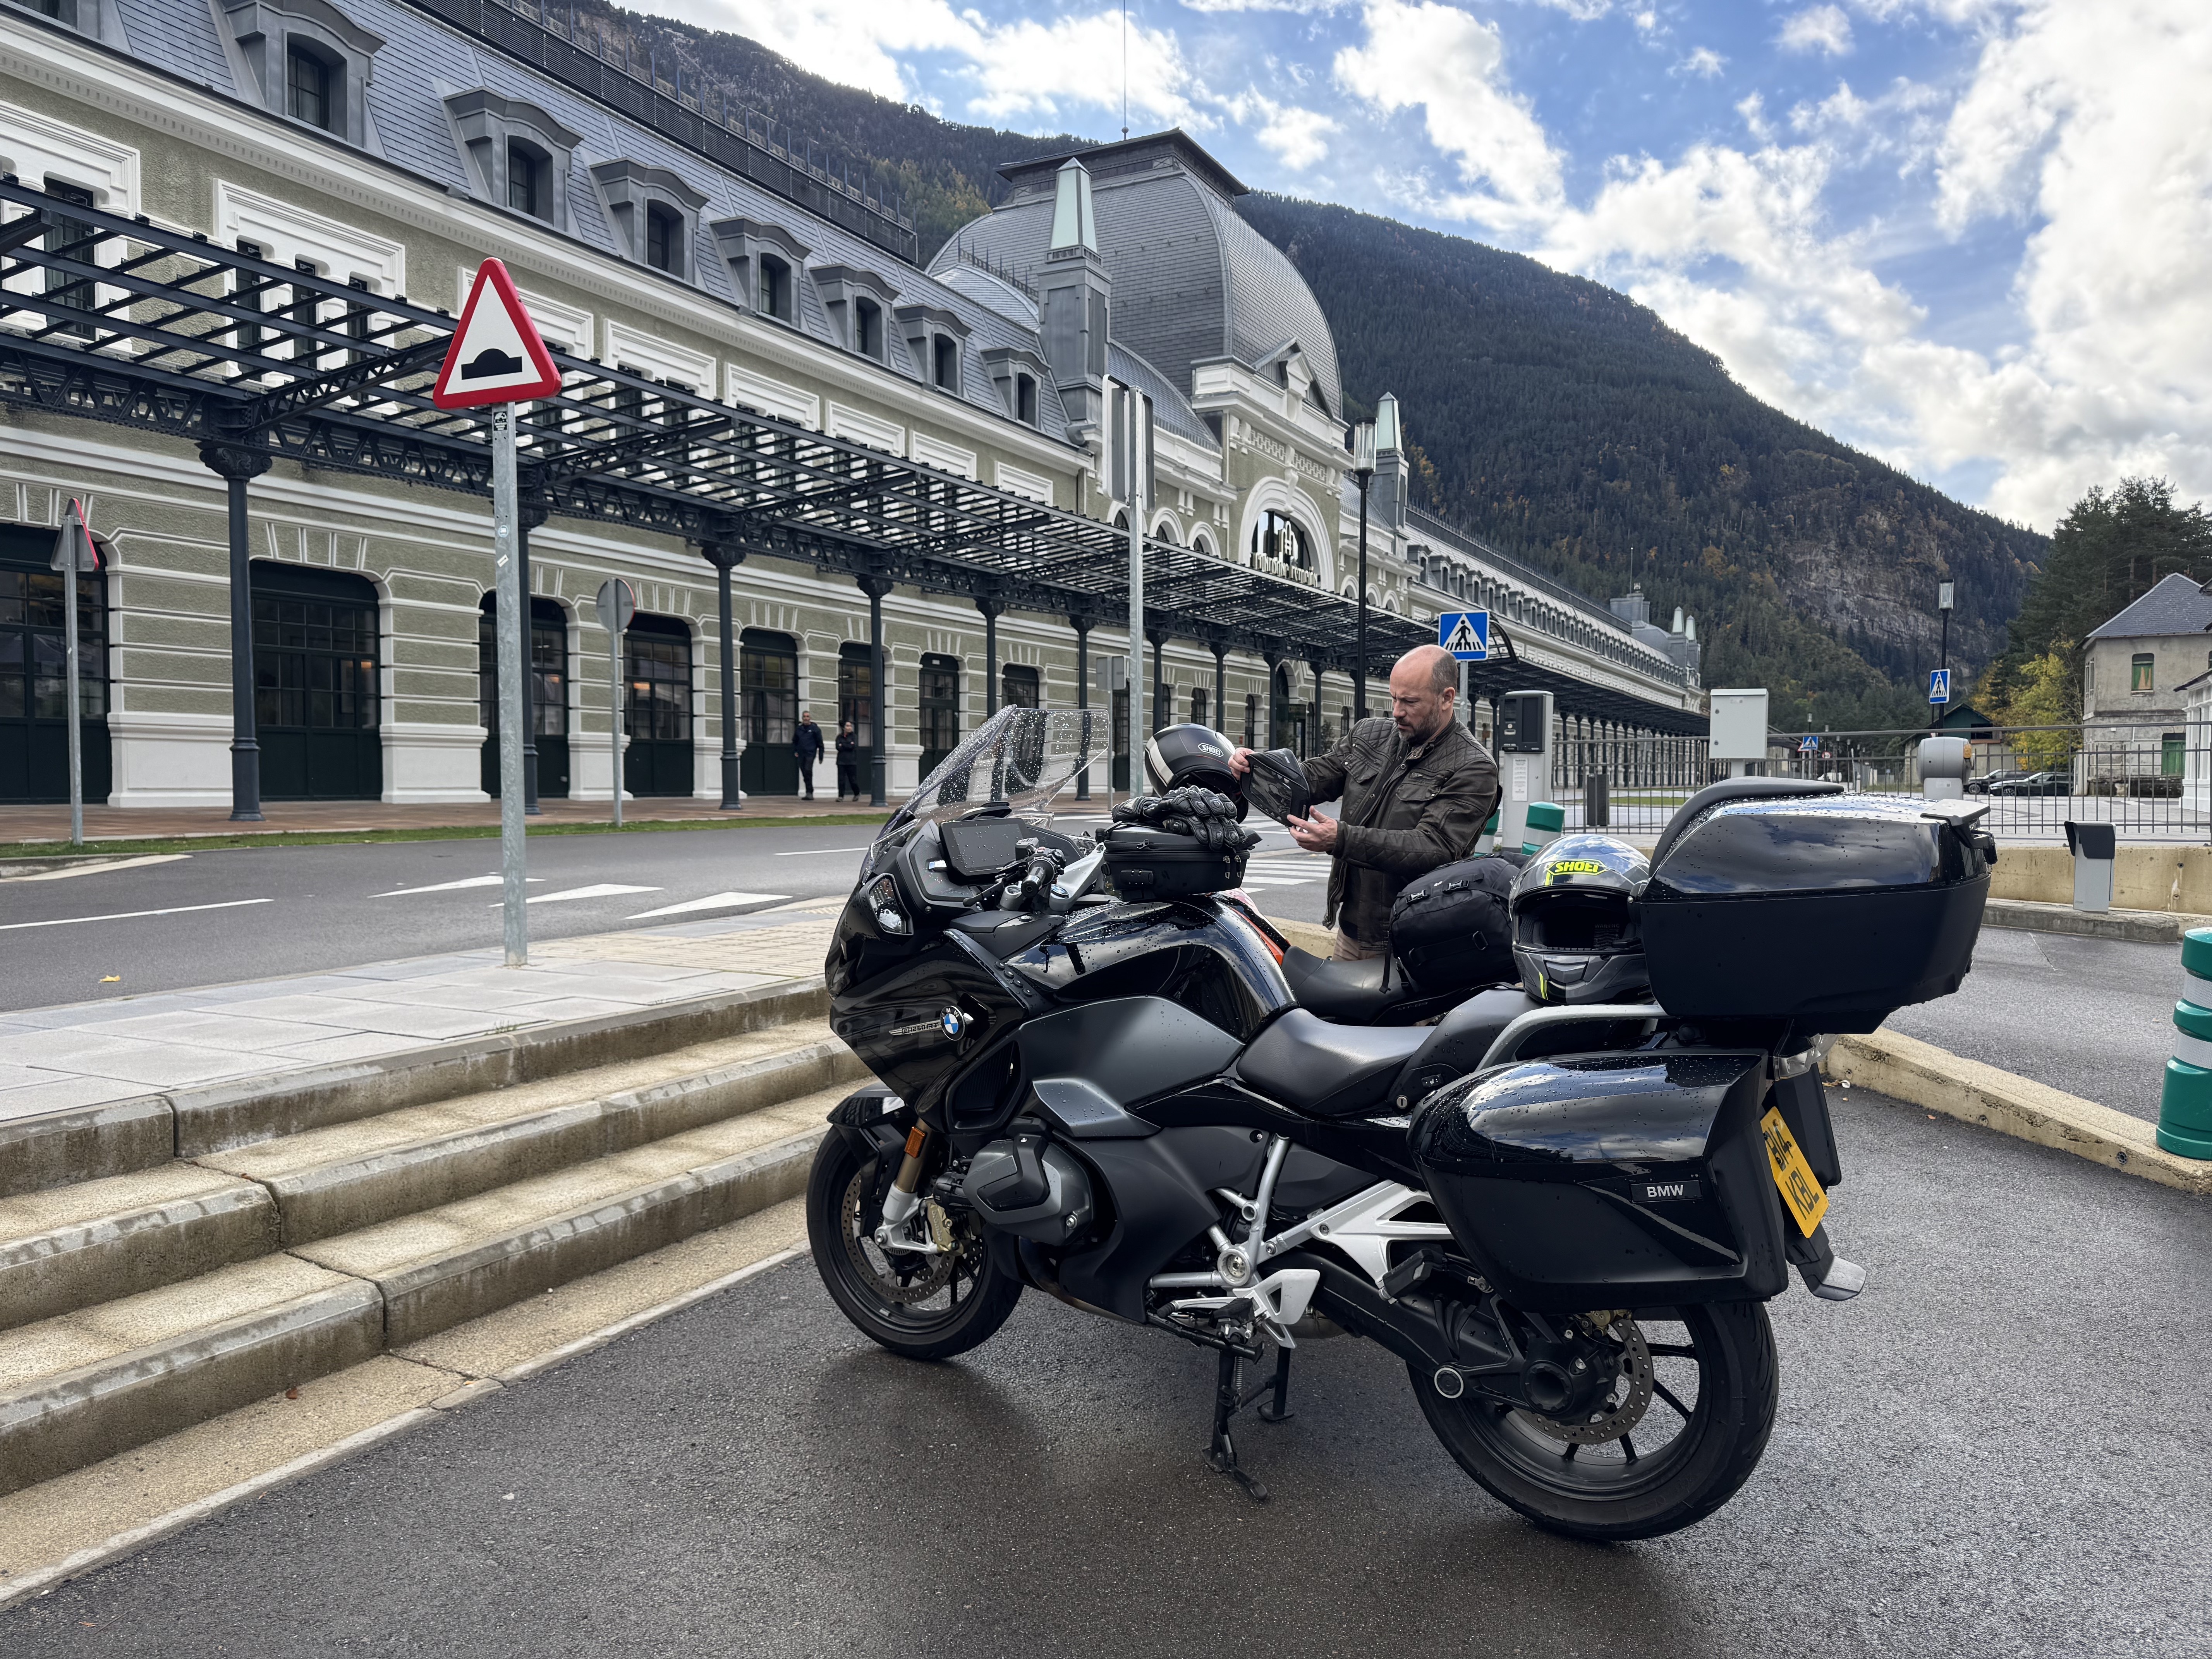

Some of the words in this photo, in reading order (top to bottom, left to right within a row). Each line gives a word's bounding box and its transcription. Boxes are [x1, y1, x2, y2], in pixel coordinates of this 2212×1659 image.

[1202, 744, 1221, 756] SHOEI
[1555, 861, 1599, 872] SHOEI
[941, 1008, 959, 1019] BMW
[1647, 1184, 1684, 1198] BMW
[1785, 1166, 1820, 1220] KBL
